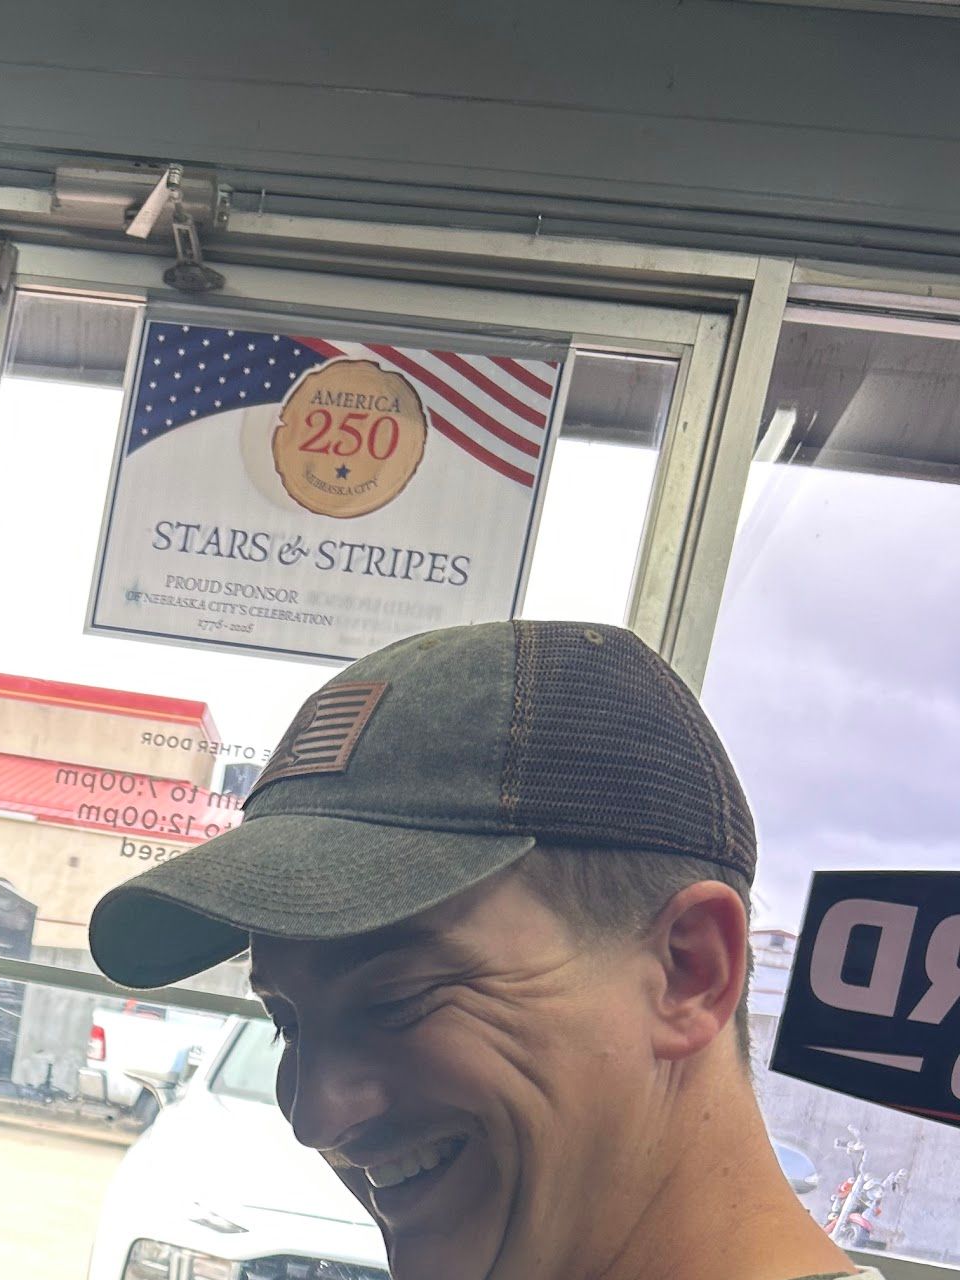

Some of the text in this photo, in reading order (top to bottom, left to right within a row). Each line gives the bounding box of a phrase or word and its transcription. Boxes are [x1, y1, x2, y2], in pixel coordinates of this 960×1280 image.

[310, 389, 401, 414] AMERICA
[299, 410, 400, 461] 250
[306, 471, 378, 496] NEBRASKA CITY
[152, 520, 471, 586] STARS & STRIPES
[166, 575, 220, 594] PROUD
[223, 582, 299, 604] SPONSOR
[126, 590, 142, 602] OF
[144, 593, 205, 610] NEBRASKA
[208, 603, 248, 614] CITY'S
[249, 606, 334, 626] CELEBRATION
